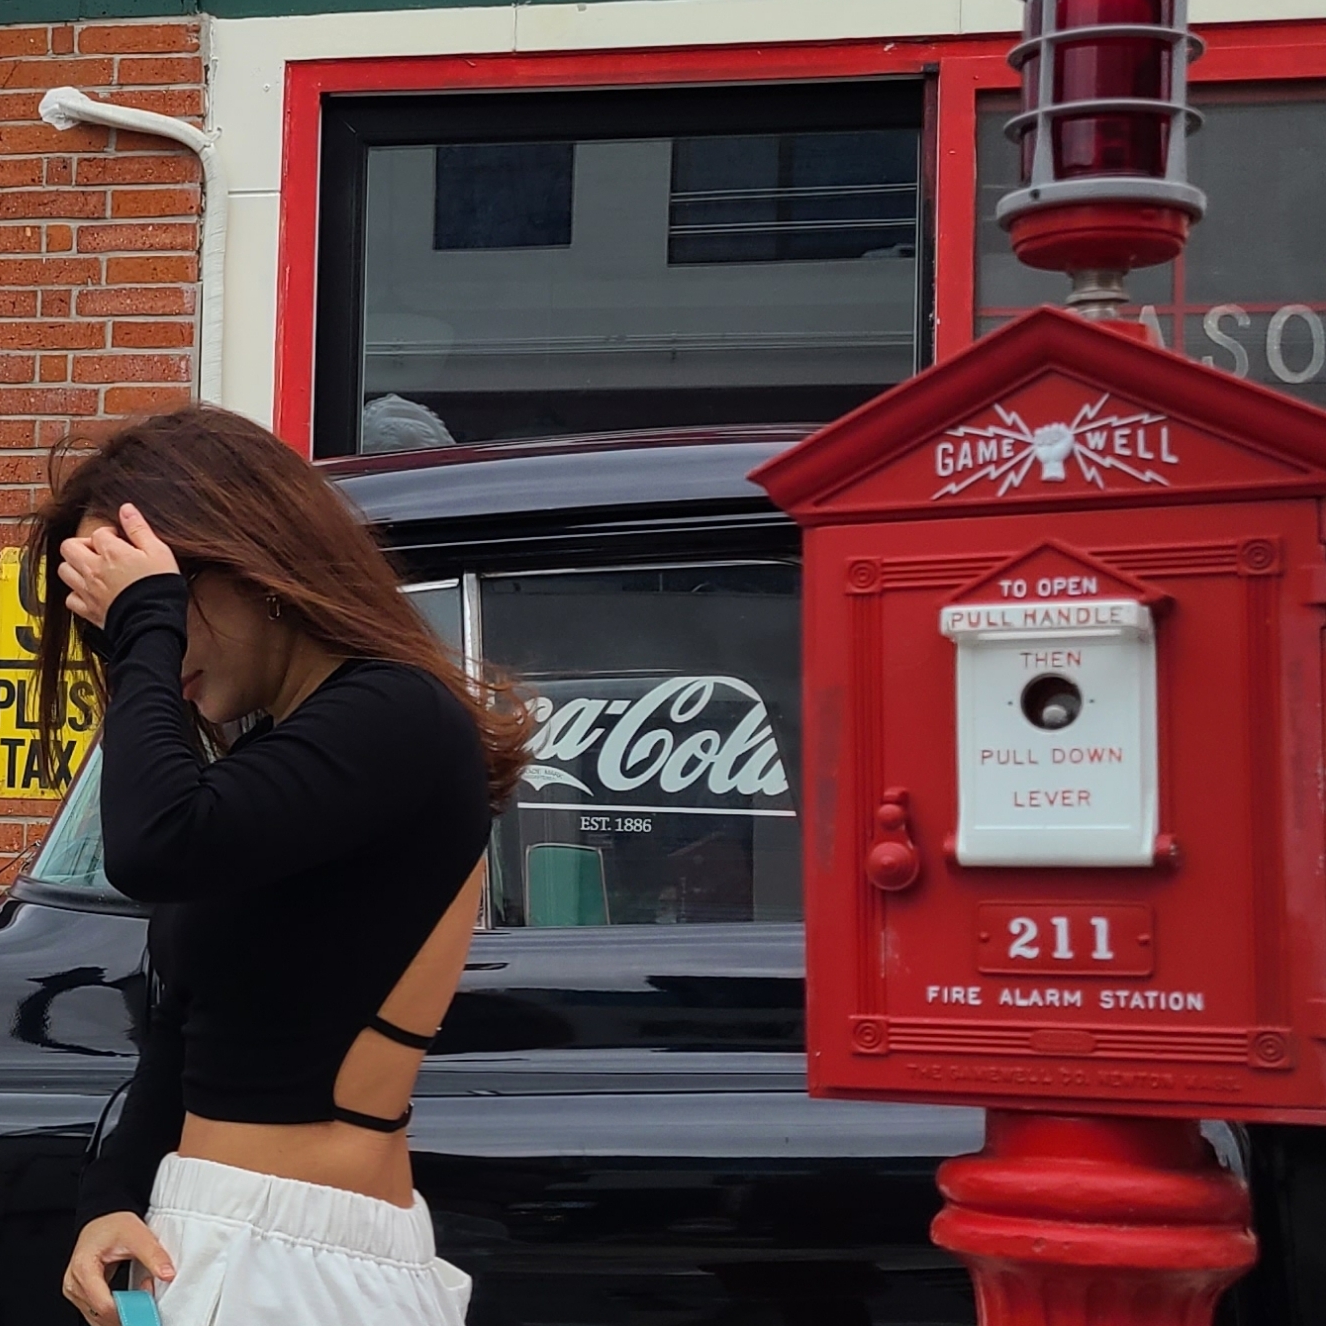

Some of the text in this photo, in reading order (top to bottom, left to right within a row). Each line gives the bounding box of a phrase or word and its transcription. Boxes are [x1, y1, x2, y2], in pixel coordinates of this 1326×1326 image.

[936, 426, 1178, 476] GAME WELL
[999, 577, 1098, 597] TO OPEN
[951, 606, 1123, 628] PULL HANDLE
[1020, 650, 1082, 668] THEN
[0, 738, 76, 789] TAX
[981, 748, 1122, 765] PULL DOWN
[1014, 790, 1091, 807] LEVER
[580, 816, 652, 832] EST. 1886
[1008, 916, 1114, 960] 211
[926, 985, 1204, 1011] FIRE ALARM STATION
